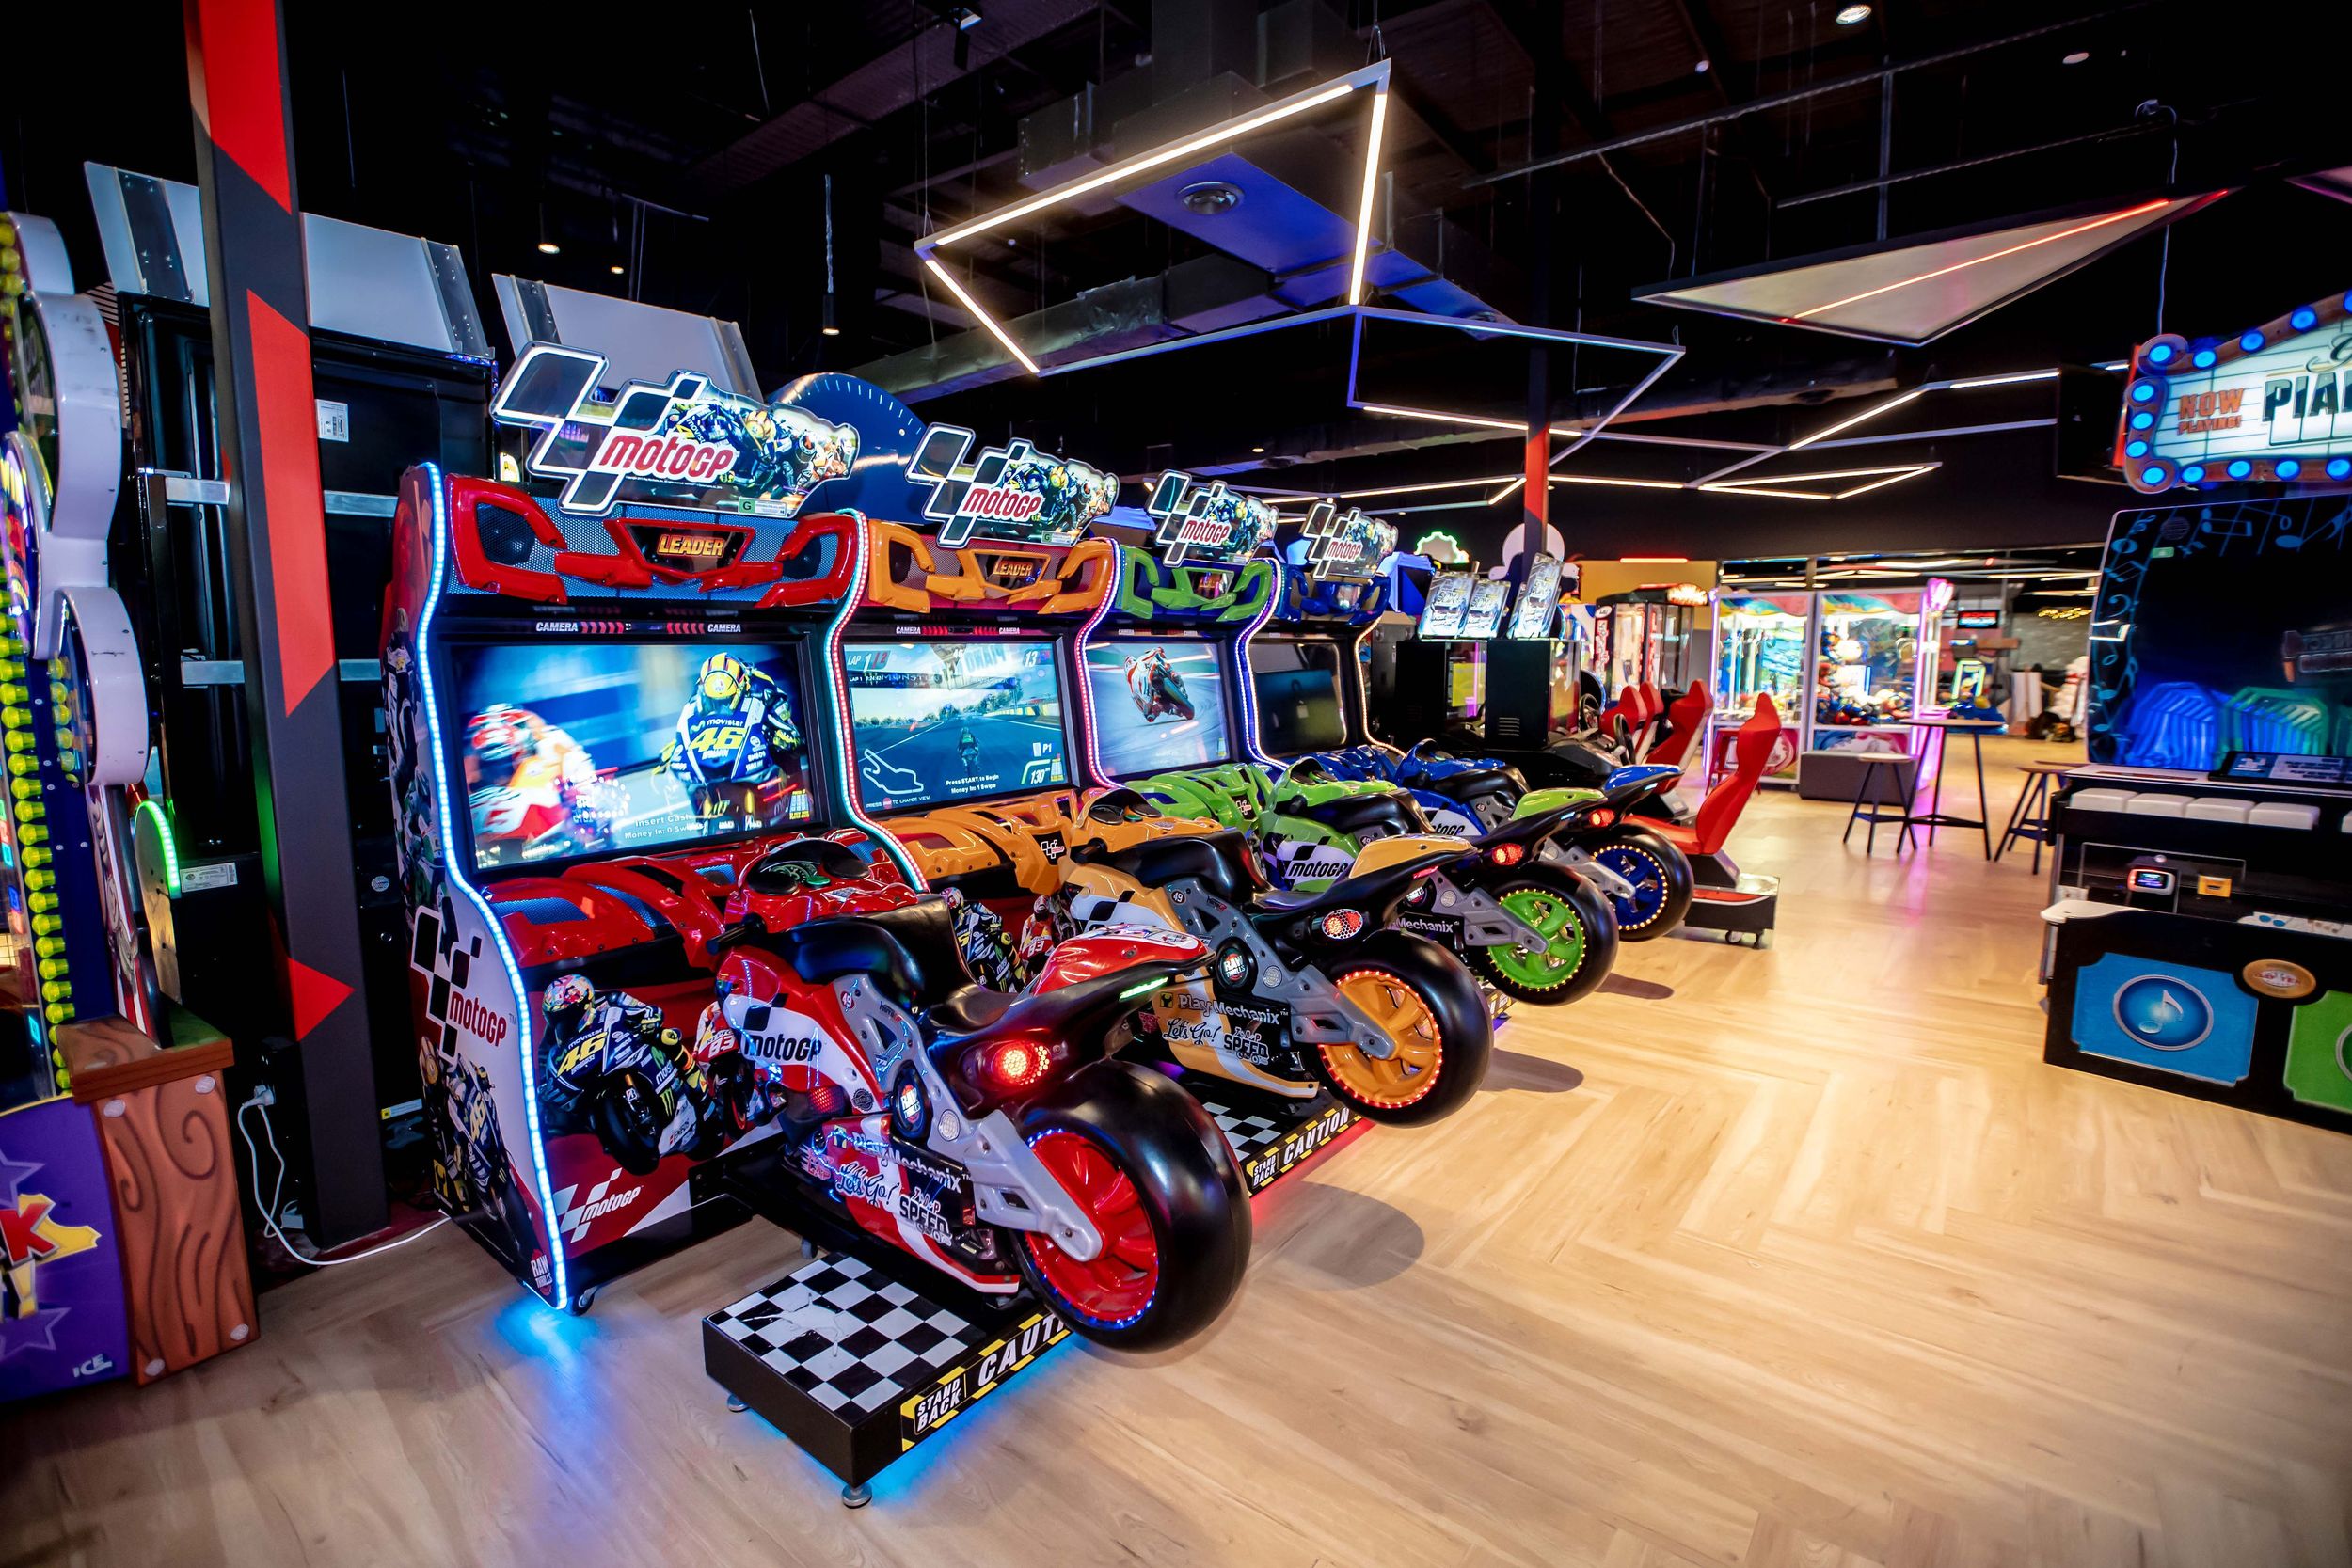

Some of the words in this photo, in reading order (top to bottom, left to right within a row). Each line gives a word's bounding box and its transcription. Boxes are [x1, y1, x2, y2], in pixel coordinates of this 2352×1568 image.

[2179, 388, 2245, 420] NOW
[2262, 371, 2352, 422] PIA
[2176, 415, 2242, 435] PLAYING!
[742, 500, 752, 511] G
[658, 534, 725, 556] LEADER
[993, 561, 1032, 577] LEADER
[535, 622, 579, 633] CAMERA
[707, 624, 741, 634] CAMERA
[896, 626, 921, 634] CAMERA
[848, 655, 862, 666] LAP
[688, 726, 748, 753] 46
[1042, 743, 1052, 753] P1
[635, 816, 664, 827] Insert
[667, 814, 692, 822] Cash
[624, 831, 652, 839] Money
[1172, 892, 1184, 903] 49
[1400, 918, 1454, 933] Mechanix
[1223, 956, 1244, 972] RAW
[1178, 993, 1213, 1017] Play
[1213, 1000, 1280, 1025] Mechanix
[567, 1028, 603, 1050] movistar
[1162, 1017, 1190, 1040] Let's
[1190, 1019, 1222, 1045] Go!
[556, 1031, 608, 1078] 46
[1224, 1034, 1268, 1058] SPEED
[1283, 1106, 1350, 1165] CAUTION
[886, 1148, 962, 1194] Mechanix
[1253, 1154, 1277, 1177] STAND
[1253, 1164, 1277, 1187] BACK
[865, 1175, 900, 1207] Go!
[899, 1196, 951, 1234] SPEED
[530, 1254, 549, 1278] RAW
[977, 1312, 1065, 1387] CAUT
[917, 1378, 961, 1418] STAND
[917, 1390, 961, 1433] BACK
